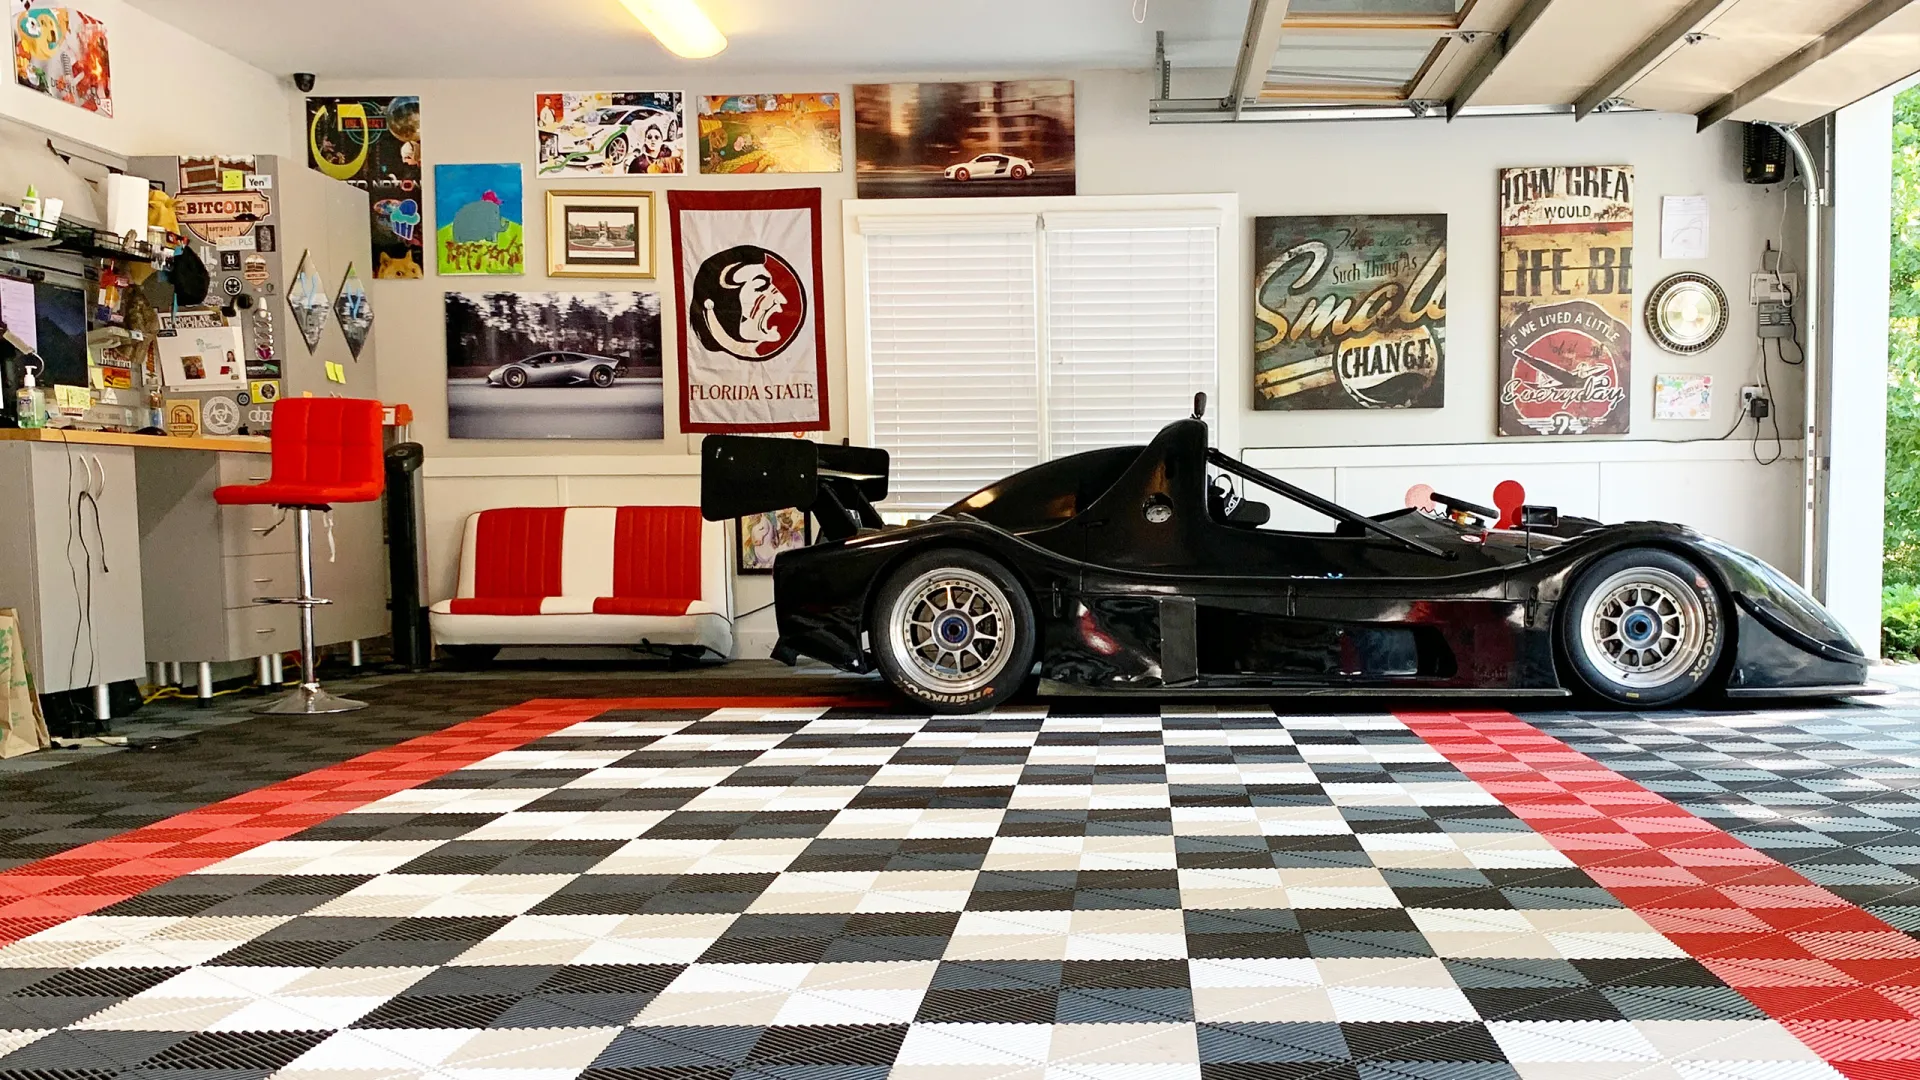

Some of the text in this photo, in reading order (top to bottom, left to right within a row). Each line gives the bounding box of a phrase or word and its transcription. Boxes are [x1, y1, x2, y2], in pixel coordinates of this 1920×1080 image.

[248, 178, 265, 187] Yen
[1565, 166, 1634, 202] GREA
[186, 200, 253, 214] BITCOIN
[1544, 205, 1592, 219] WOULD
[1332, 262, 1361, 285] Such
[1363, 258, 1399, 279] Thing
[1507, 311, 1620, 347] IF WE LIVED A LITTLE
[1341, 338, 1431, 379] CHANGE
[690, 383, 814, 400] FLORIDA STATE
[1500, 376, 1626, 410] Everyday
